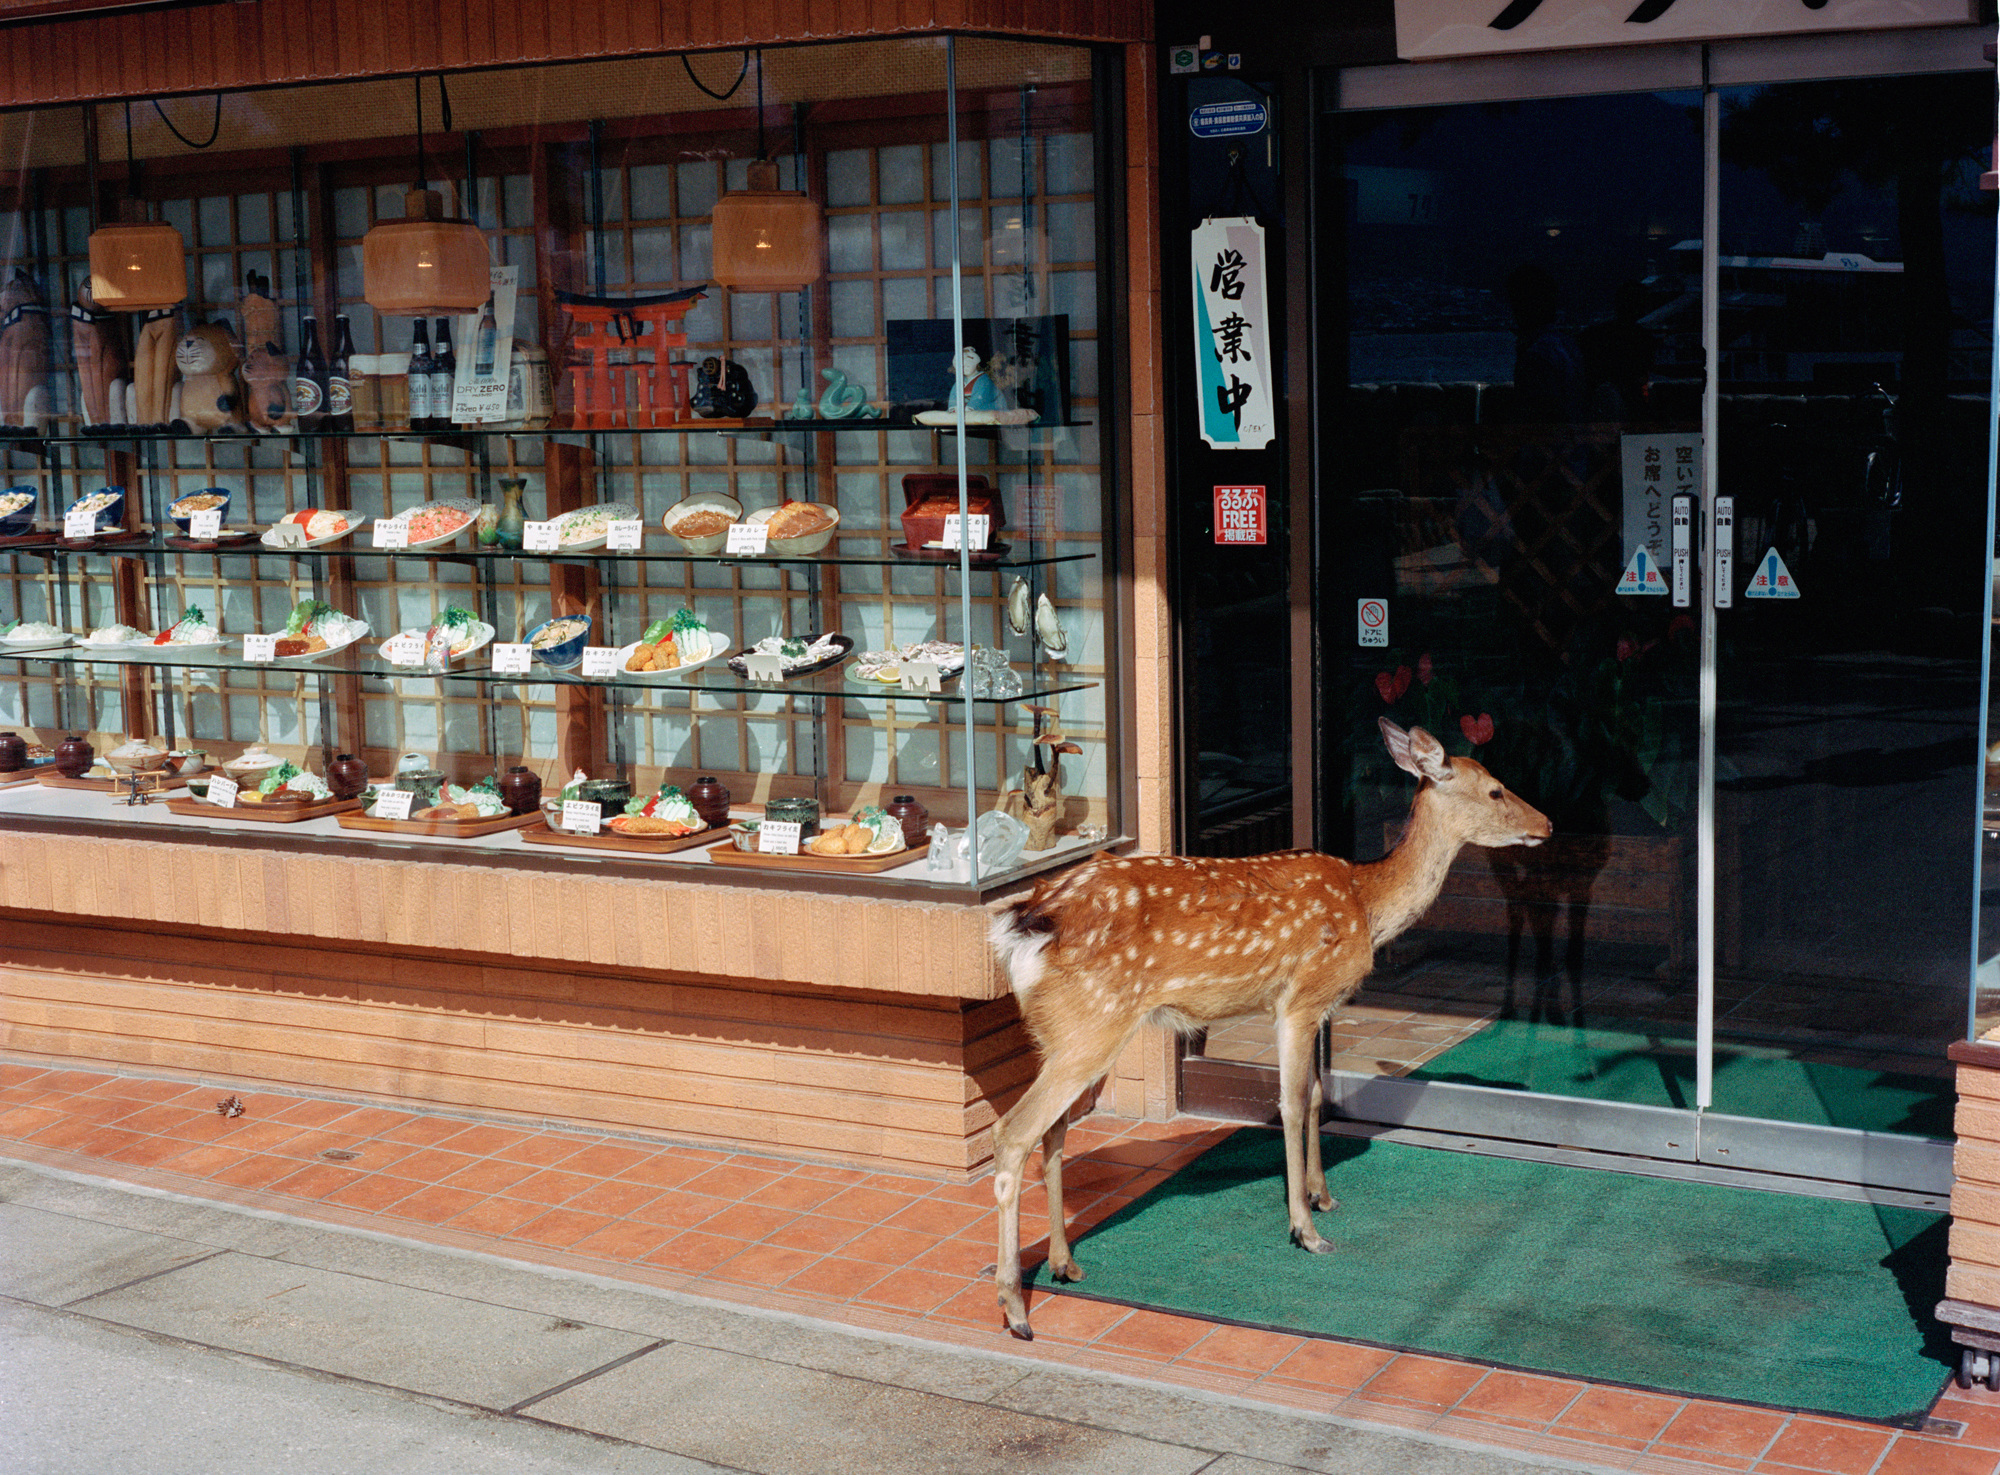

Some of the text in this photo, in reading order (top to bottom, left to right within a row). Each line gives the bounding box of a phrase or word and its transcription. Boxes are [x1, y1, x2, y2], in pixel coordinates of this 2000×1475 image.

[1210, 249, 1253, 433] 営業中
[457, 384, 506, 394] DRY ZERO
[1221, 488, 1259, 510] るるぶ
[1644, 446, 1662, 557] お席へどうぞ
[1674, 506, 1689, 515] AUTO
[1717, 506, 1732, 516] AUTO
[1222, 510, 1257, 528] FREE
[1674, 517, 1689, 526] 自動
[1716, 517, 1731, 526] 自動
[1224, 529, 1257, 542] 掲載店
[1674, 548, 1689, 557] PUSH
[1716, 548, 1731, 557] PUSH
[1626, 571, 1657, 582] 注意
[1756, 575, 1789, 586] 注意
